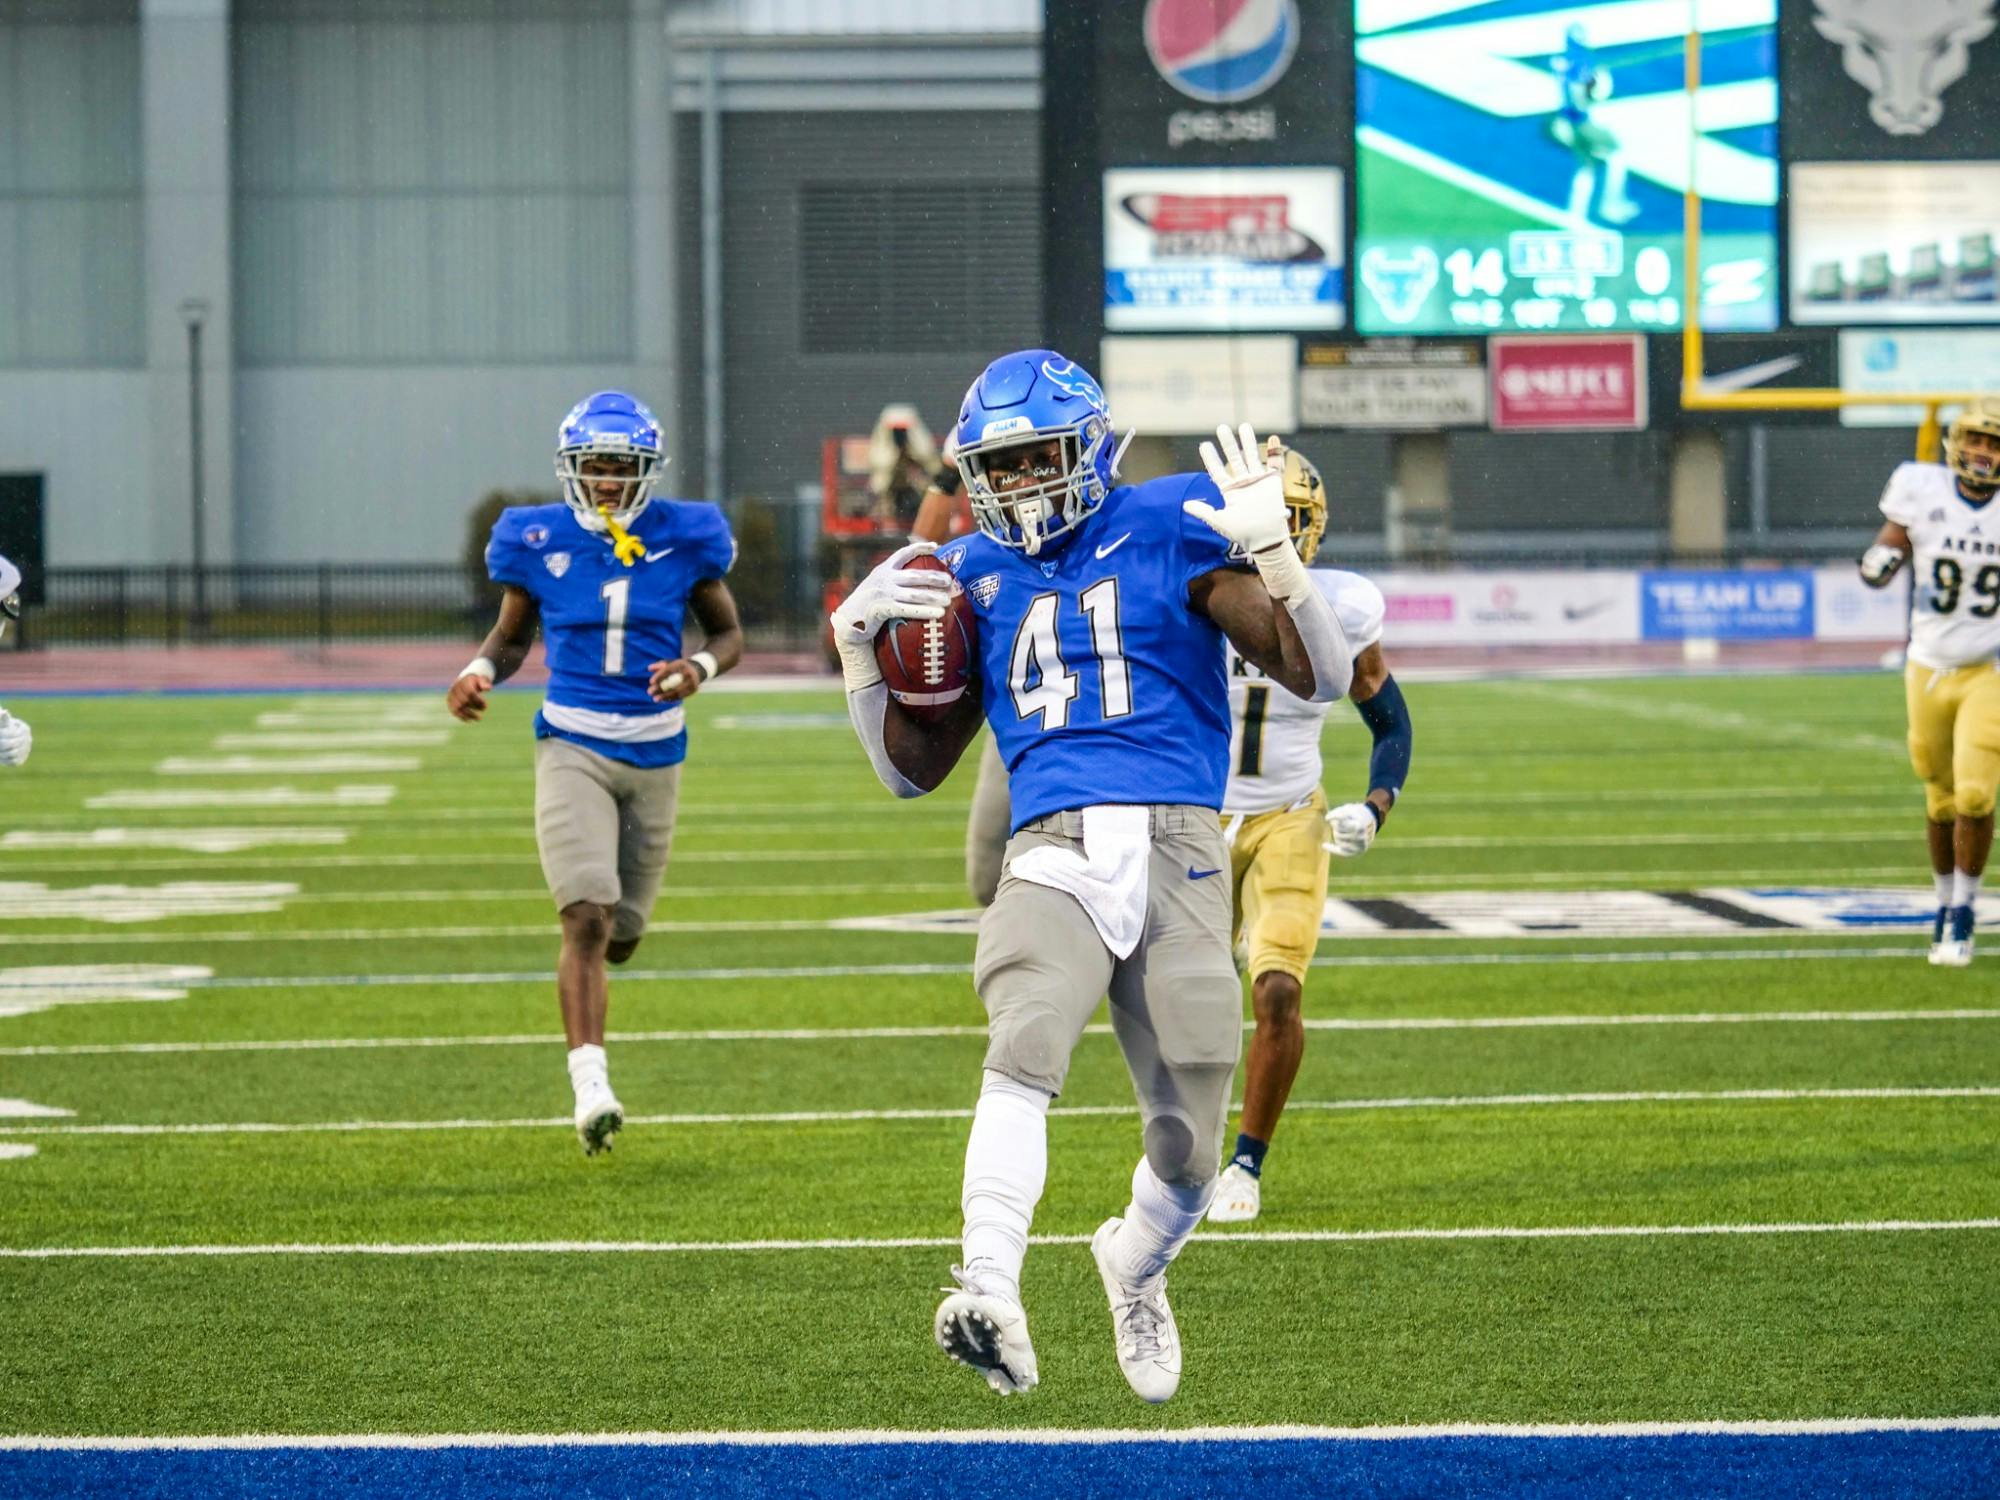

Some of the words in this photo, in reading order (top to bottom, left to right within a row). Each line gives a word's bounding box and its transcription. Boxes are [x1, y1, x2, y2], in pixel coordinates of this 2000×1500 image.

[1167, 105, 1277, 148] pepsi
[1445, 248, 1507, 297] 14
[1941, 536, 2000, 556] AKRO
[1651, 582, 1750, 610] TEAM
[1930, 557, 2000, 618] 99
[600, 577, 630, 677] 1
[1008, 574, 1132, 732] 41
